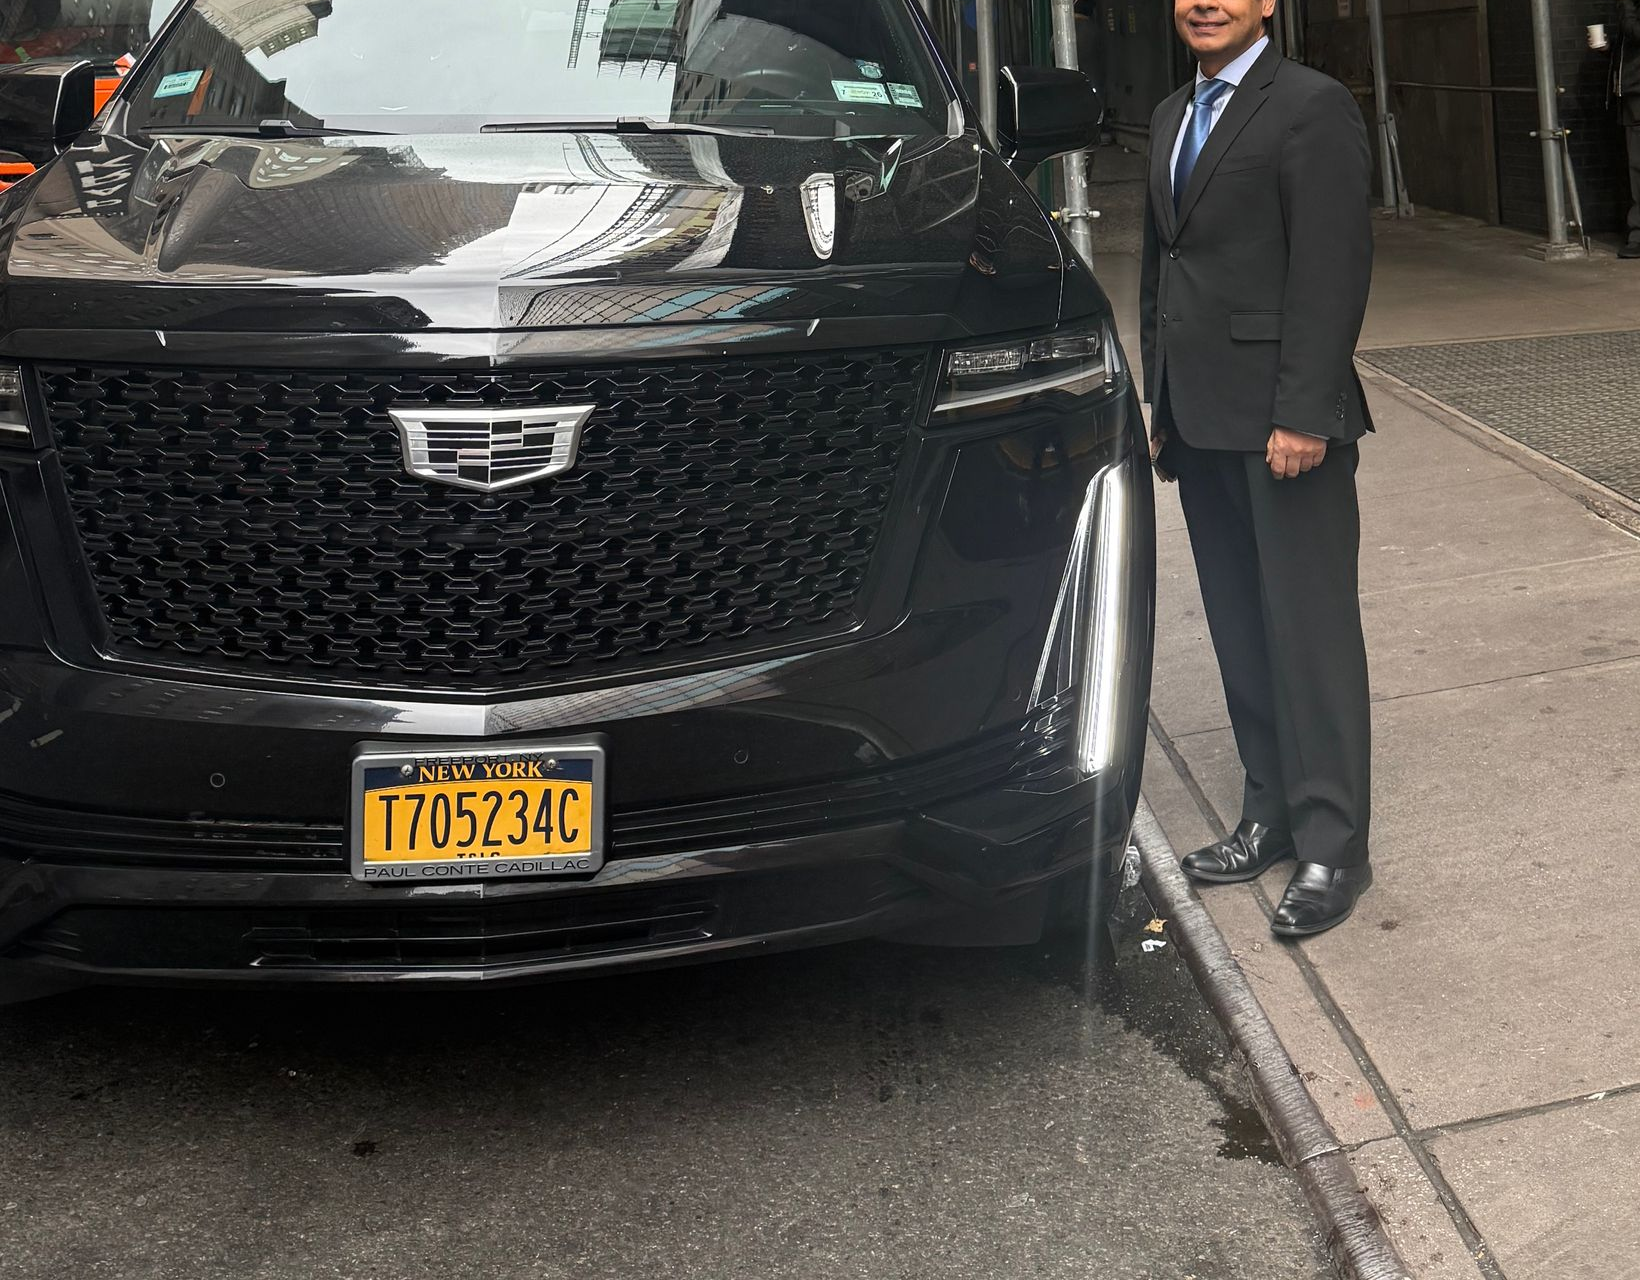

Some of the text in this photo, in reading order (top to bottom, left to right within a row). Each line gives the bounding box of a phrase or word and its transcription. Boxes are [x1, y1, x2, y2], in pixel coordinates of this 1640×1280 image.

[519, 753, 544, 764] NY
[418, 760, 544, 783] NEW YORK
[378, 788, 579, 851] T705234C
[364, 859, 590, 878] PAUL CONTE CADILLAC
